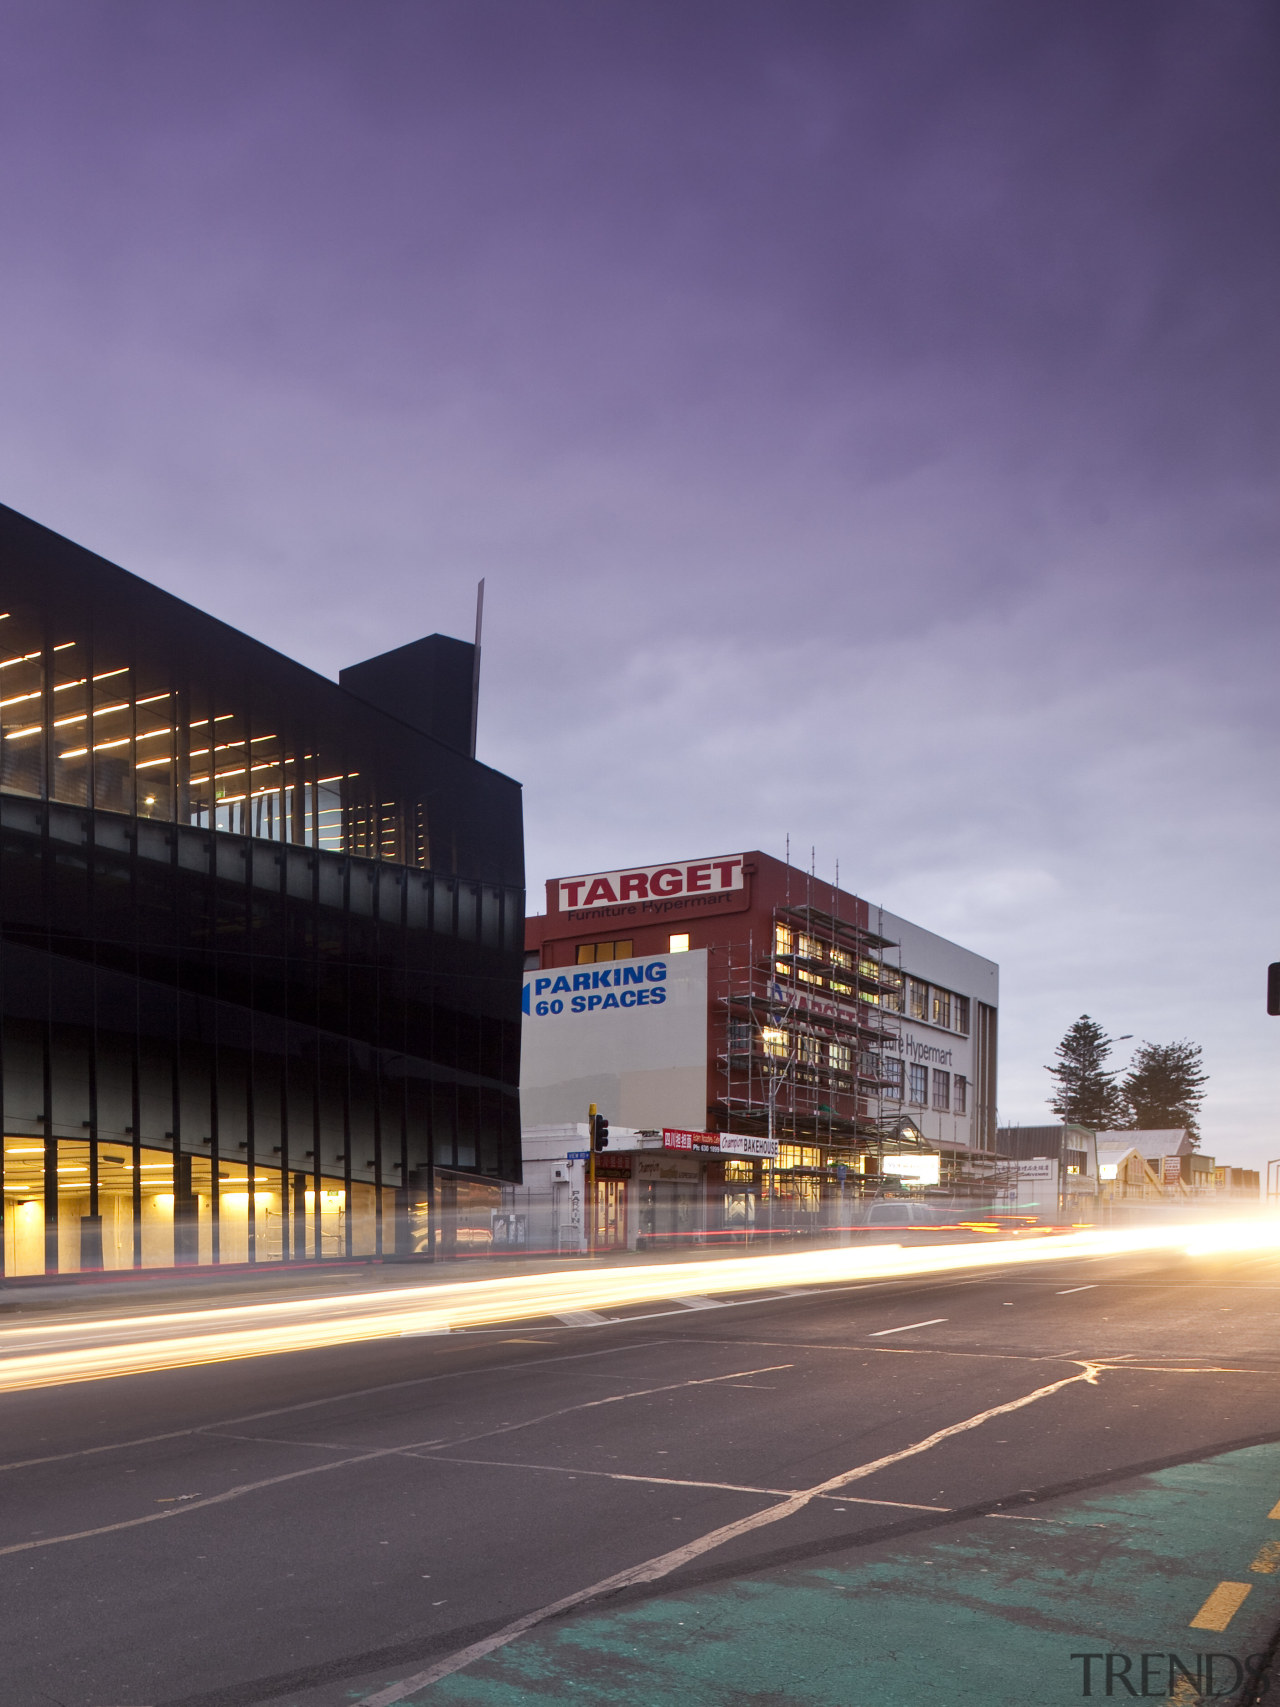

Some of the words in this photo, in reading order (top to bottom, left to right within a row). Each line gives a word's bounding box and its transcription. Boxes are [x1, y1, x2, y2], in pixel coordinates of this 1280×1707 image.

[560, 859, 742, 907] TARGET
[567, 904, 637, 922] Furniture
[642, 891, 733, 915] Hypermart
[535, 961, 667, 996] PARKING
[535, 999, 564, 1016] 60
[571, 986, 667, 1013] SPACES
[905, 1033, 953, 1066] Hypermart
[743, 1138, 778, 1155] BAKEHOUSE
